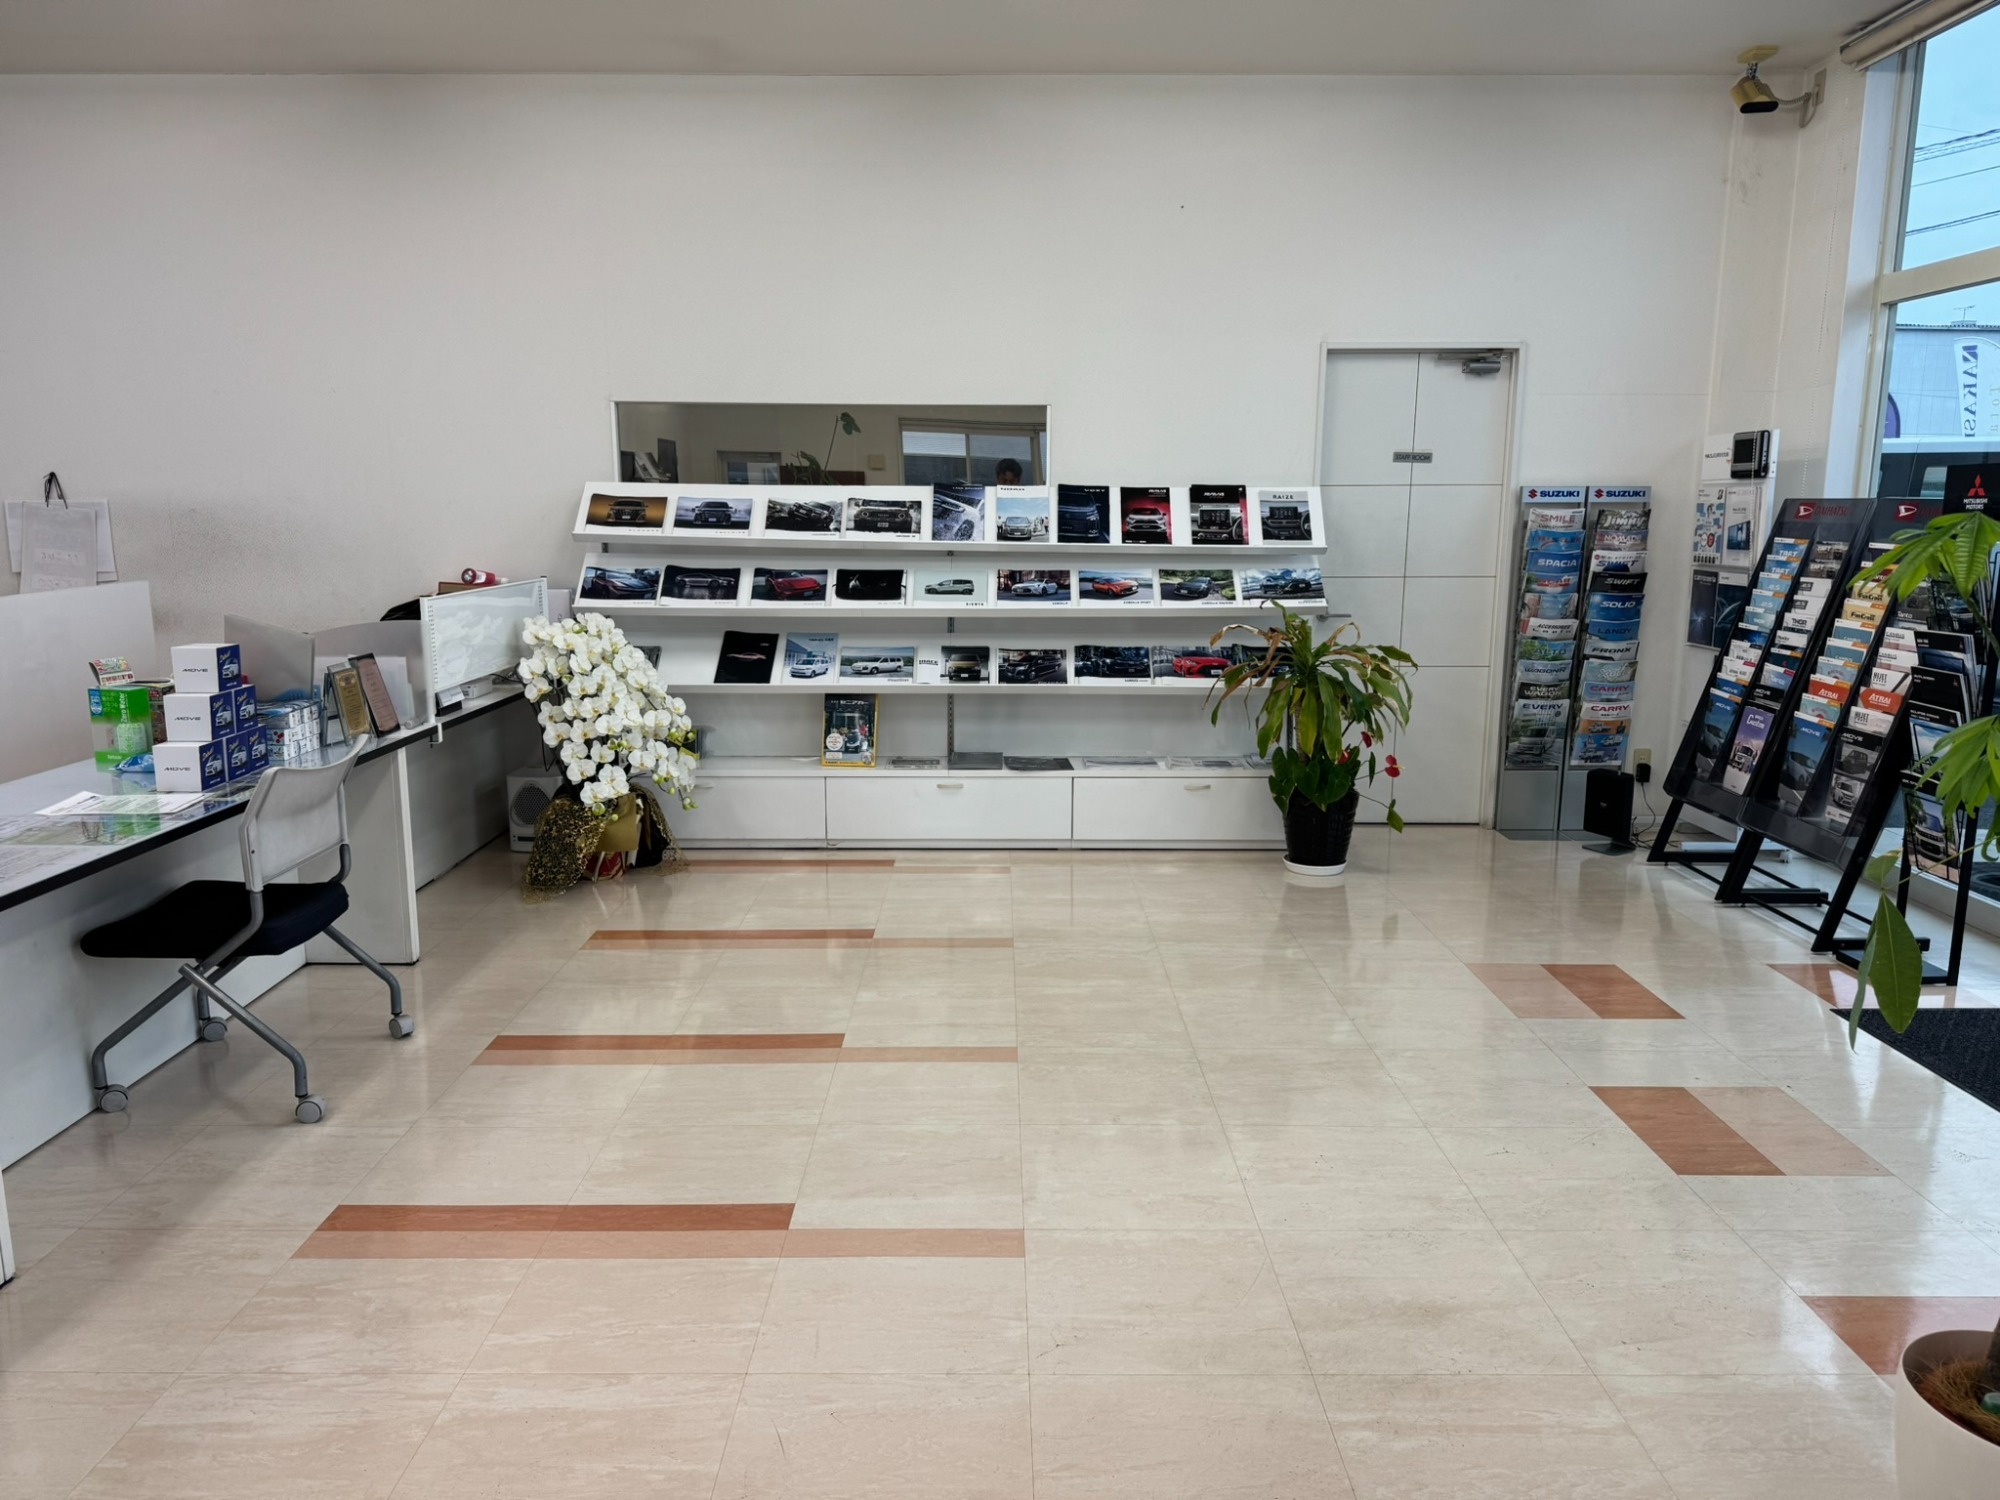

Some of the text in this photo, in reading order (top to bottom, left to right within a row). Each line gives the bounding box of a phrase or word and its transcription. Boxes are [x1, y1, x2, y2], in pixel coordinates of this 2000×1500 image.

[1540, 490, 1580, 498] SUZUKI
[1606, 490, 1646, 498] SUZUKI
[1815, 506, 1848, 516] DAIHATSU
[1537, 558, 1577, 567] SPACIA
[1597, 627, 1632, 635] LANDY
[1818, 688, 1839, 700] ATRAI
[1868, 693, 1892, 704] ATRAI
[119, 692, 128, 724] Zero Water
[1590, 704, 1630, 712] CARRY
[1800, 726, 1821, 737] MOVE
[1842, 732, 1863, 742] MOVE
